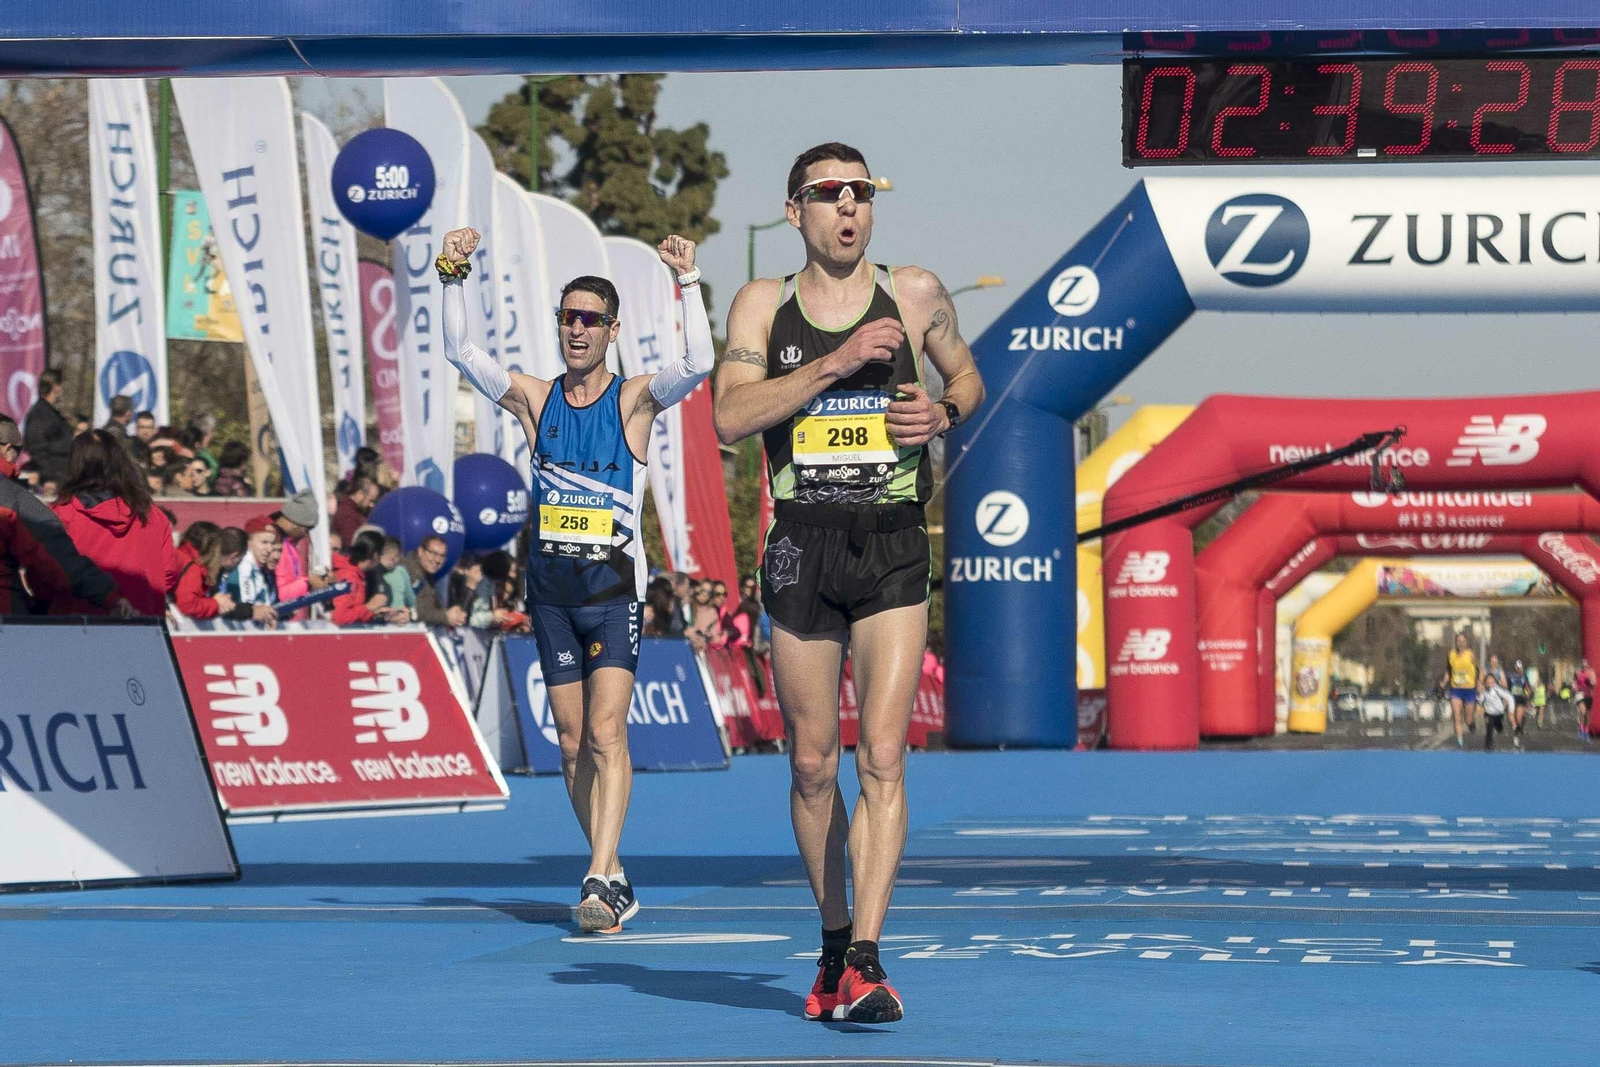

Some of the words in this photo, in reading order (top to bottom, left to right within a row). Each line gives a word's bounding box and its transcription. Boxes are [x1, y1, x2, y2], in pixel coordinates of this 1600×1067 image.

[375, 165, 409, 189] 5:00
[367, 188, 418, 201] ZURICH
[1348, 211, 1600, 267] ZURIC
[1008, 326, 1124, 351] ZURICH
[826, 396, 884, 411] ZURICH
[827, 426, 869, 447] 298
[562, 494, 604, 506] ZURICH
[560, 515, 589, 531] 258
[563, 534, 581, 542] ANGEL
[950, 556, 1052, 582] ZURICH
[1129, 583, 1178, 598] balance
[1130, 661, 1179, 676] balance
[213, 760, 254, 787] new
[251, 756, 339, 787] balance
[352, 757, 394, 782] new
[388, 751, 474, 780] balance
